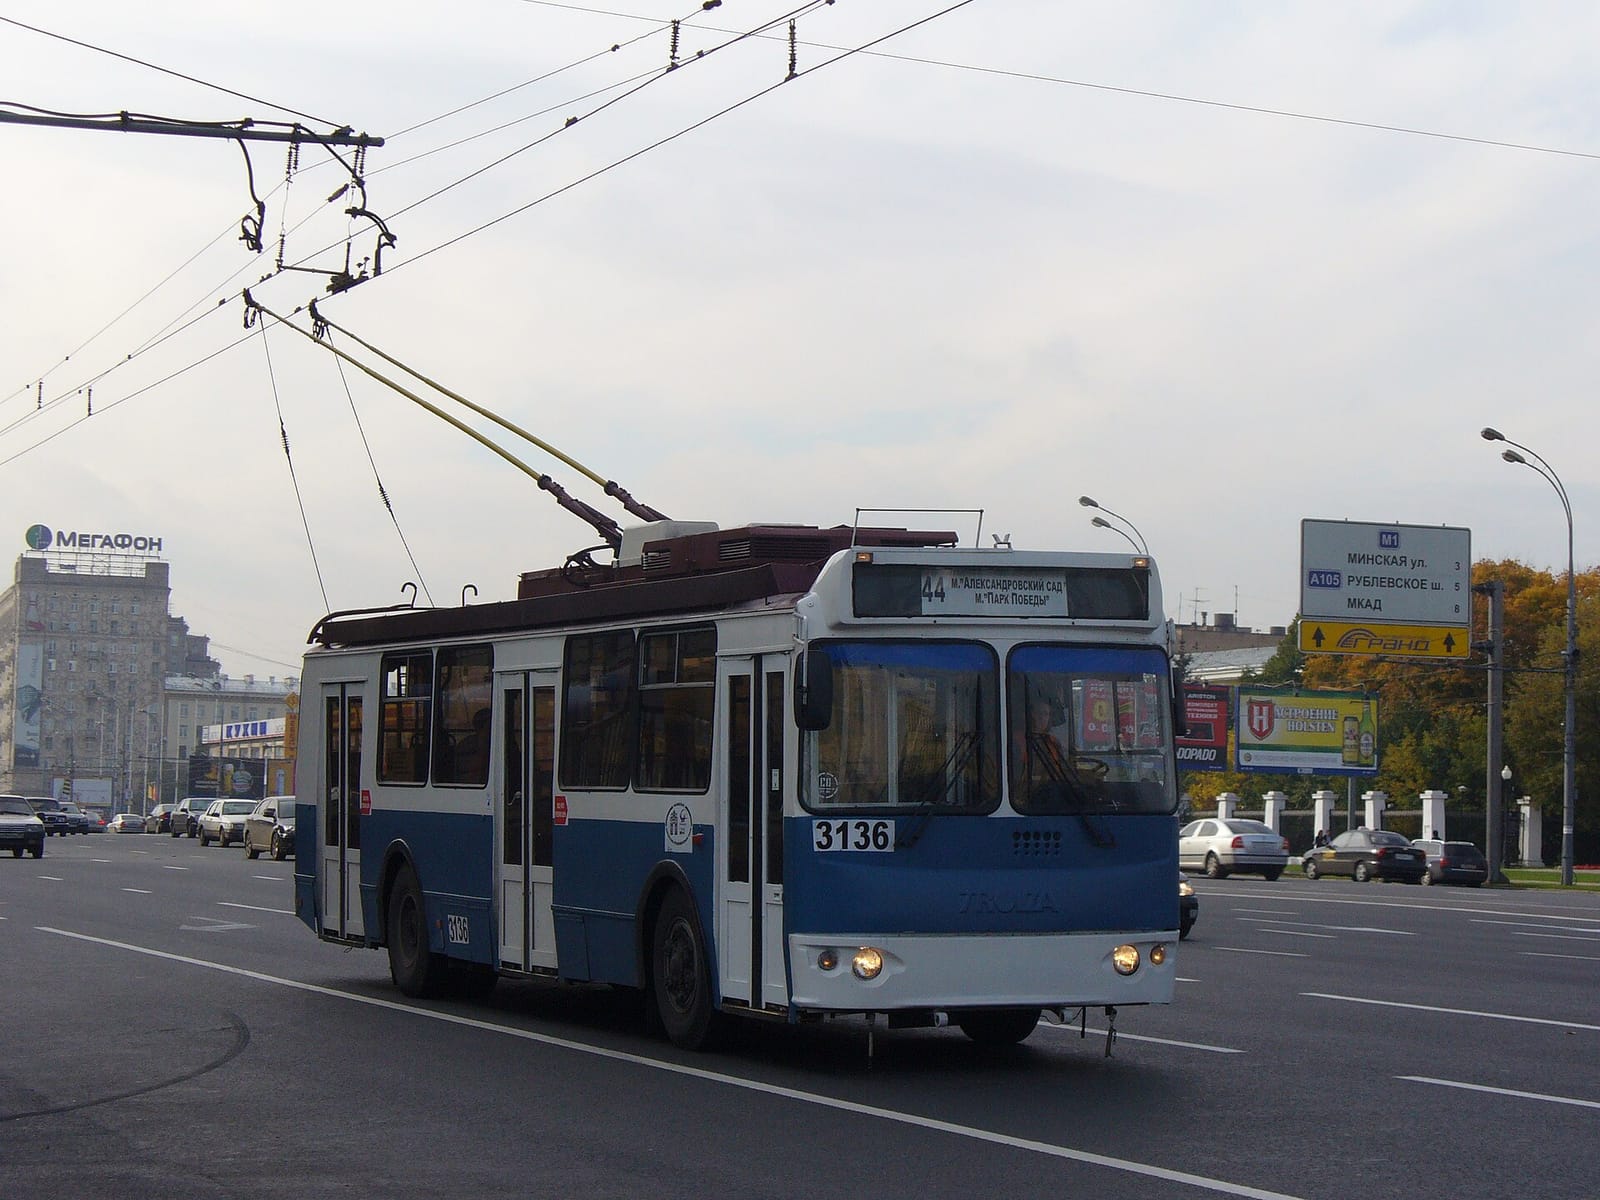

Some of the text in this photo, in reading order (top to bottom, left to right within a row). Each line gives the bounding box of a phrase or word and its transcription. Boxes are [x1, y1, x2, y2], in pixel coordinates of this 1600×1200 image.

[1347, 553, 1461, 571] МИНСКАЯ ул. 3
[922, 575, 946, 602] 44
[1347, 575, 1461, 591] РУБЛЕВСКОЕ ш. 5
[1347, 598, 1383, 612] МКАД
[1287, 721, 1336, 733] HOLSTEN
[815, 821, 890, 850] 3136
[448, 916, 469, 943] 3136
